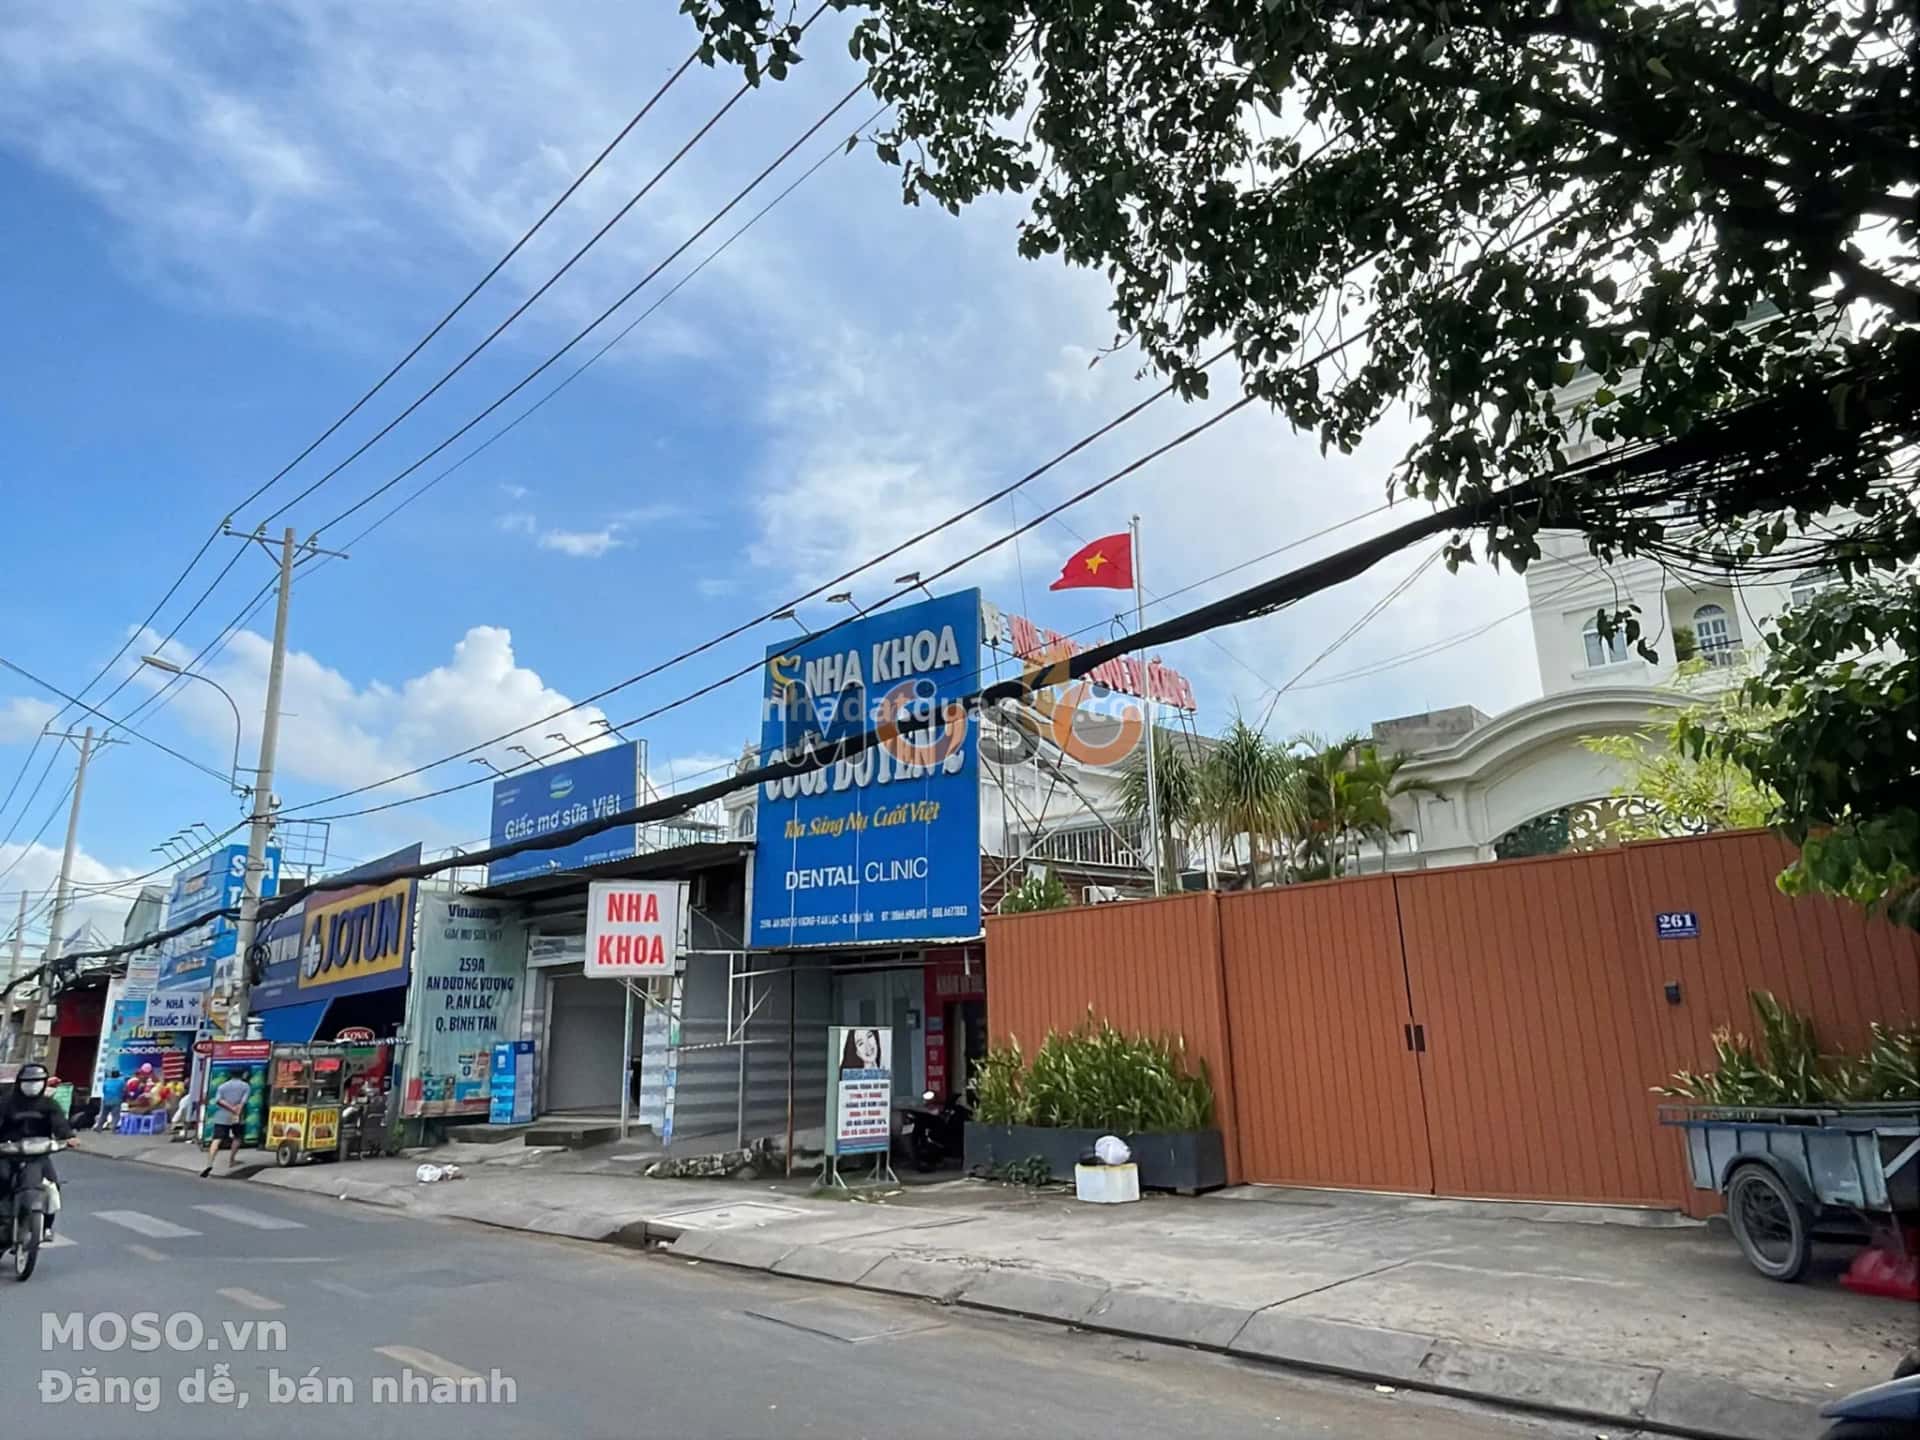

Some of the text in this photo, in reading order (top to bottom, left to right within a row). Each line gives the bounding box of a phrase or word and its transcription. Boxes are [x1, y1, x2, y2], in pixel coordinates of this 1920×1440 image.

[805, 651, 864, 696] NHA
[872, 625, 960, 683] KHOA
[785, 856, 928, 891] DENTAL CLINIC
[607, 893, 659, 923] NHA
[1659, 913, 1694, 929] 261
[322, 892, 405, 974] JOTUN
[459, 957, 485, 973] 259A
[597, 935, 665, 966] KHOA
